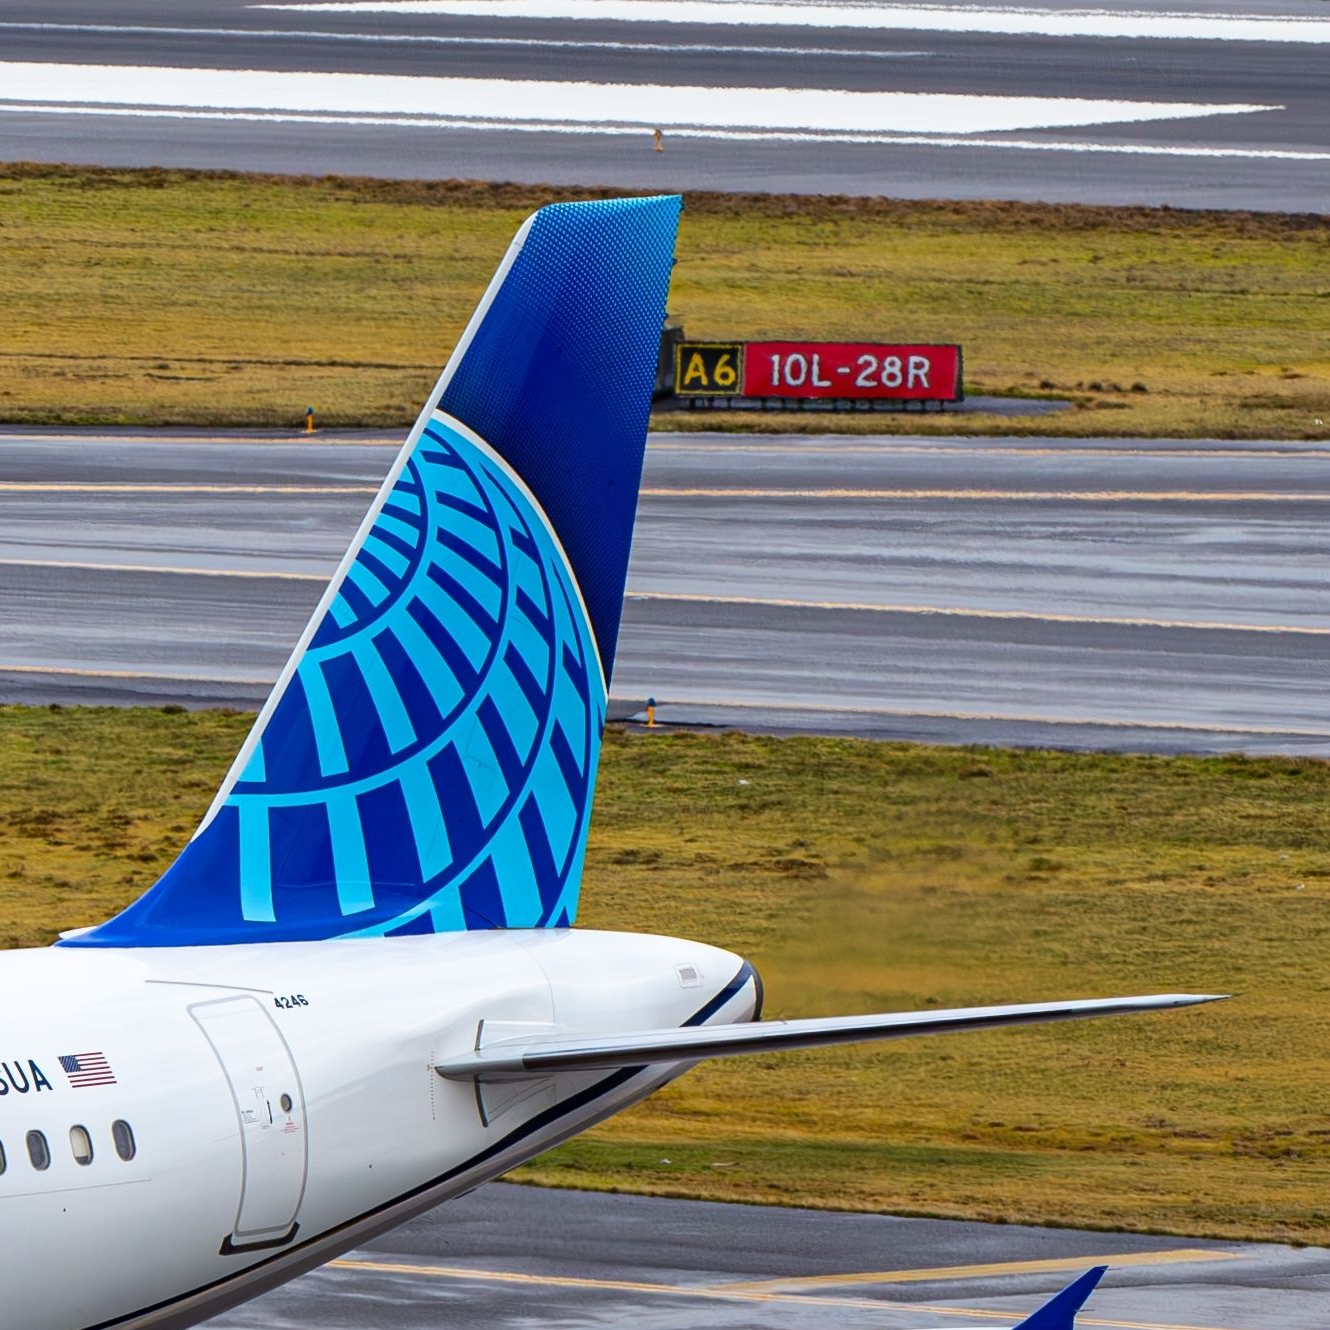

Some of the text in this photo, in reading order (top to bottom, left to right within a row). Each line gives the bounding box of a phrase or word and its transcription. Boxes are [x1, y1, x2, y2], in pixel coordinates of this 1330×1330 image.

[683, 352, 930, 389] A6 10L-28R
[273, 994, 309, 1010] 4246
